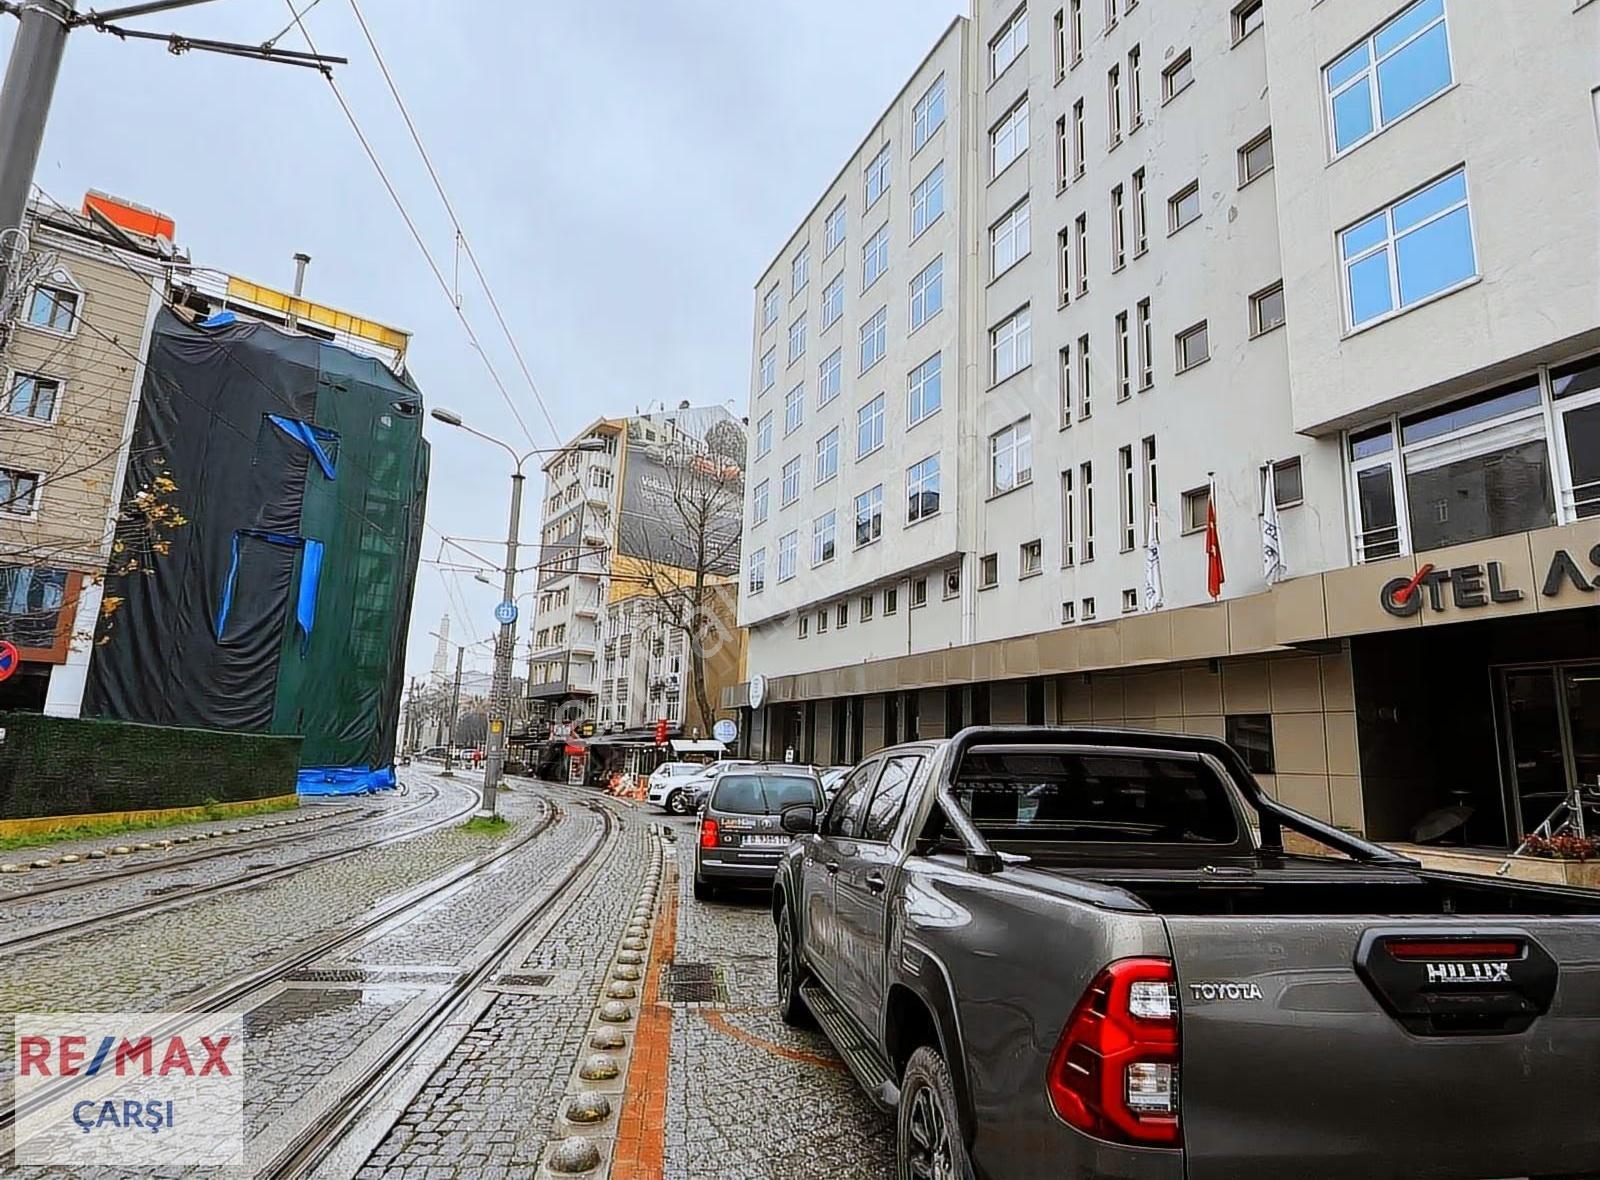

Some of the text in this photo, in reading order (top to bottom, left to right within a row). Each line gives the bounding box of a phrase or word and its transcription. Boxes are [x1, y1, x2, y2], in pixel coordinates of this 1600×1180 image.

[1379, 560, 1525, 618] OTEL
[1426, 963, 1513, 984] HILUX
[1190, 983, 1264, 1000] TOYOTA
